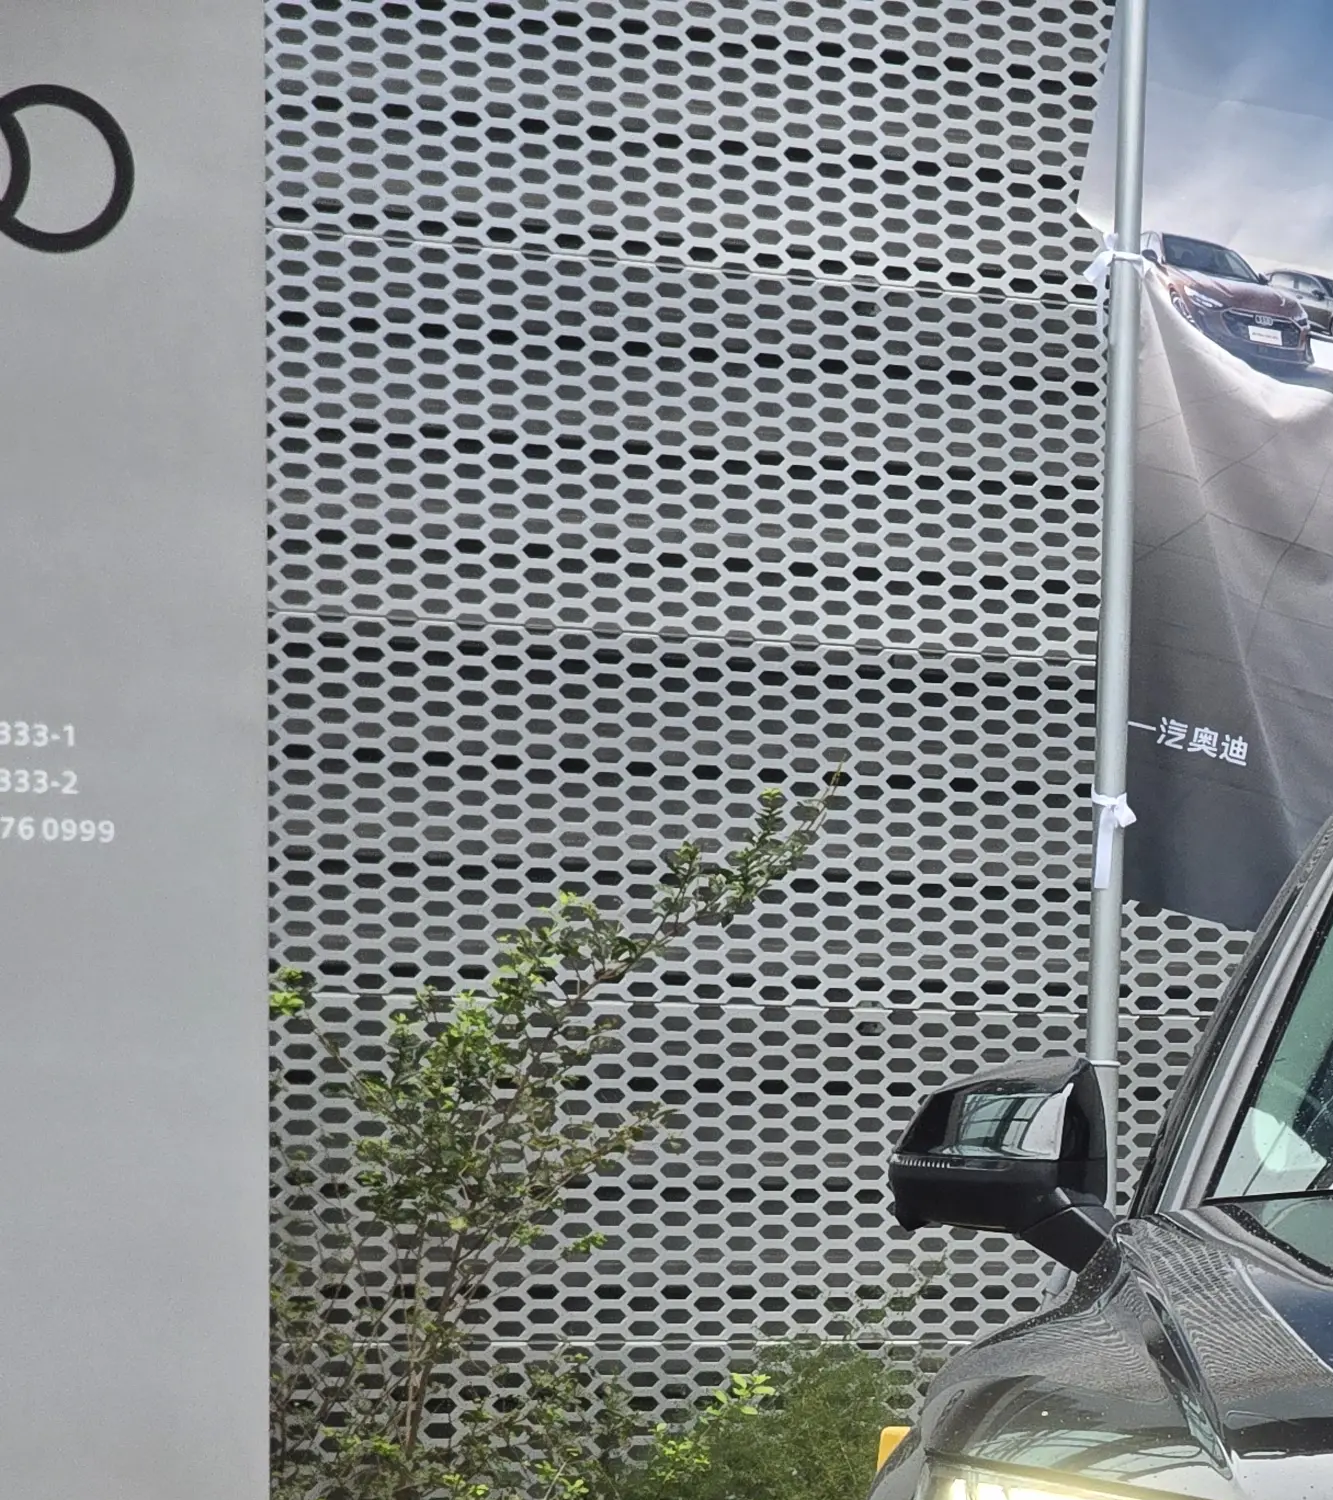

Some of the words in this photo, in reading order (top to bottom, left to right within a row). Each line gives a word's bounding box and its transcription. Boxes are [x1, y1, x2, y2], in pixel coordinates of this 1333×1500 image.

[1128, 716, 1248, 767] 一汽奥迪
[0, 817, 35, 841] 76
[41, 817, 115, 843] 0999
